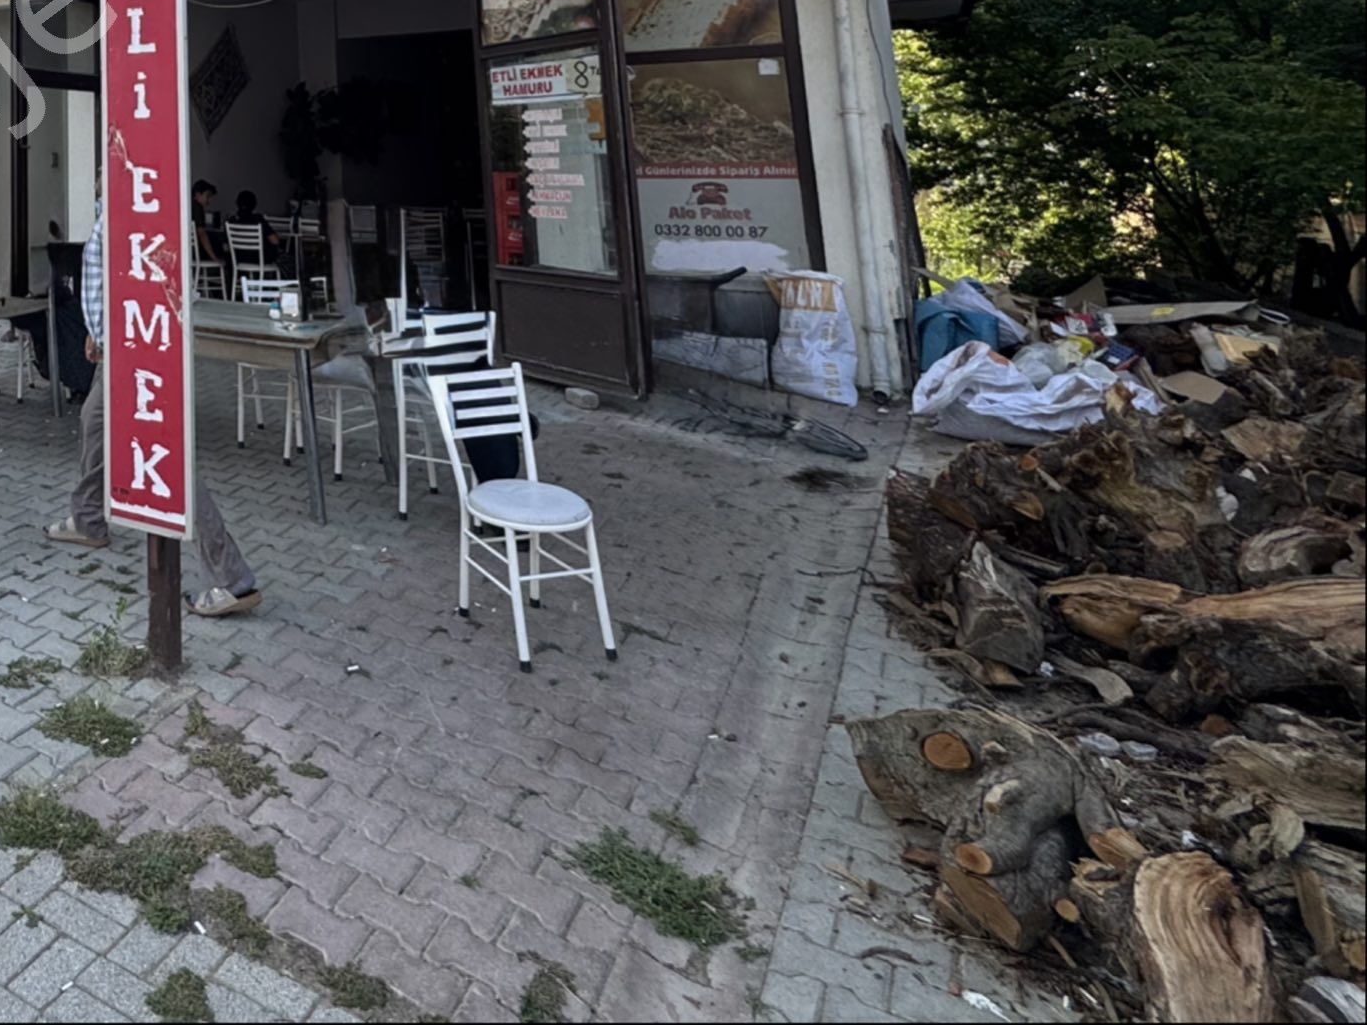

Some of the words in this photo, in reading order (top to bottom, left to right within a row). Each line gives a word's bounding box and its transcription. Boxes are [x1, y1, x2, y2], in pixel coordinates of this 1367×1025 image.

[520, 64, 563, 80] EKMEK
[574, 61, 590, 89] 8
[503, 82, 553, 96] HAMURU
[645, 166, 717, 176] Günlerinizde
[719, 166, 761, 178] Sipariş
[669, 206, 697, 220] Alo
[700, 207, 752, 221] Paket
[654, 223, 691, 237] 0332
[695, 224, 722, 238] 800
[725, 226, 745, 238] 00
[748, 226, 769, 239] 87
[122, 165, 172, 498] EKMEK
